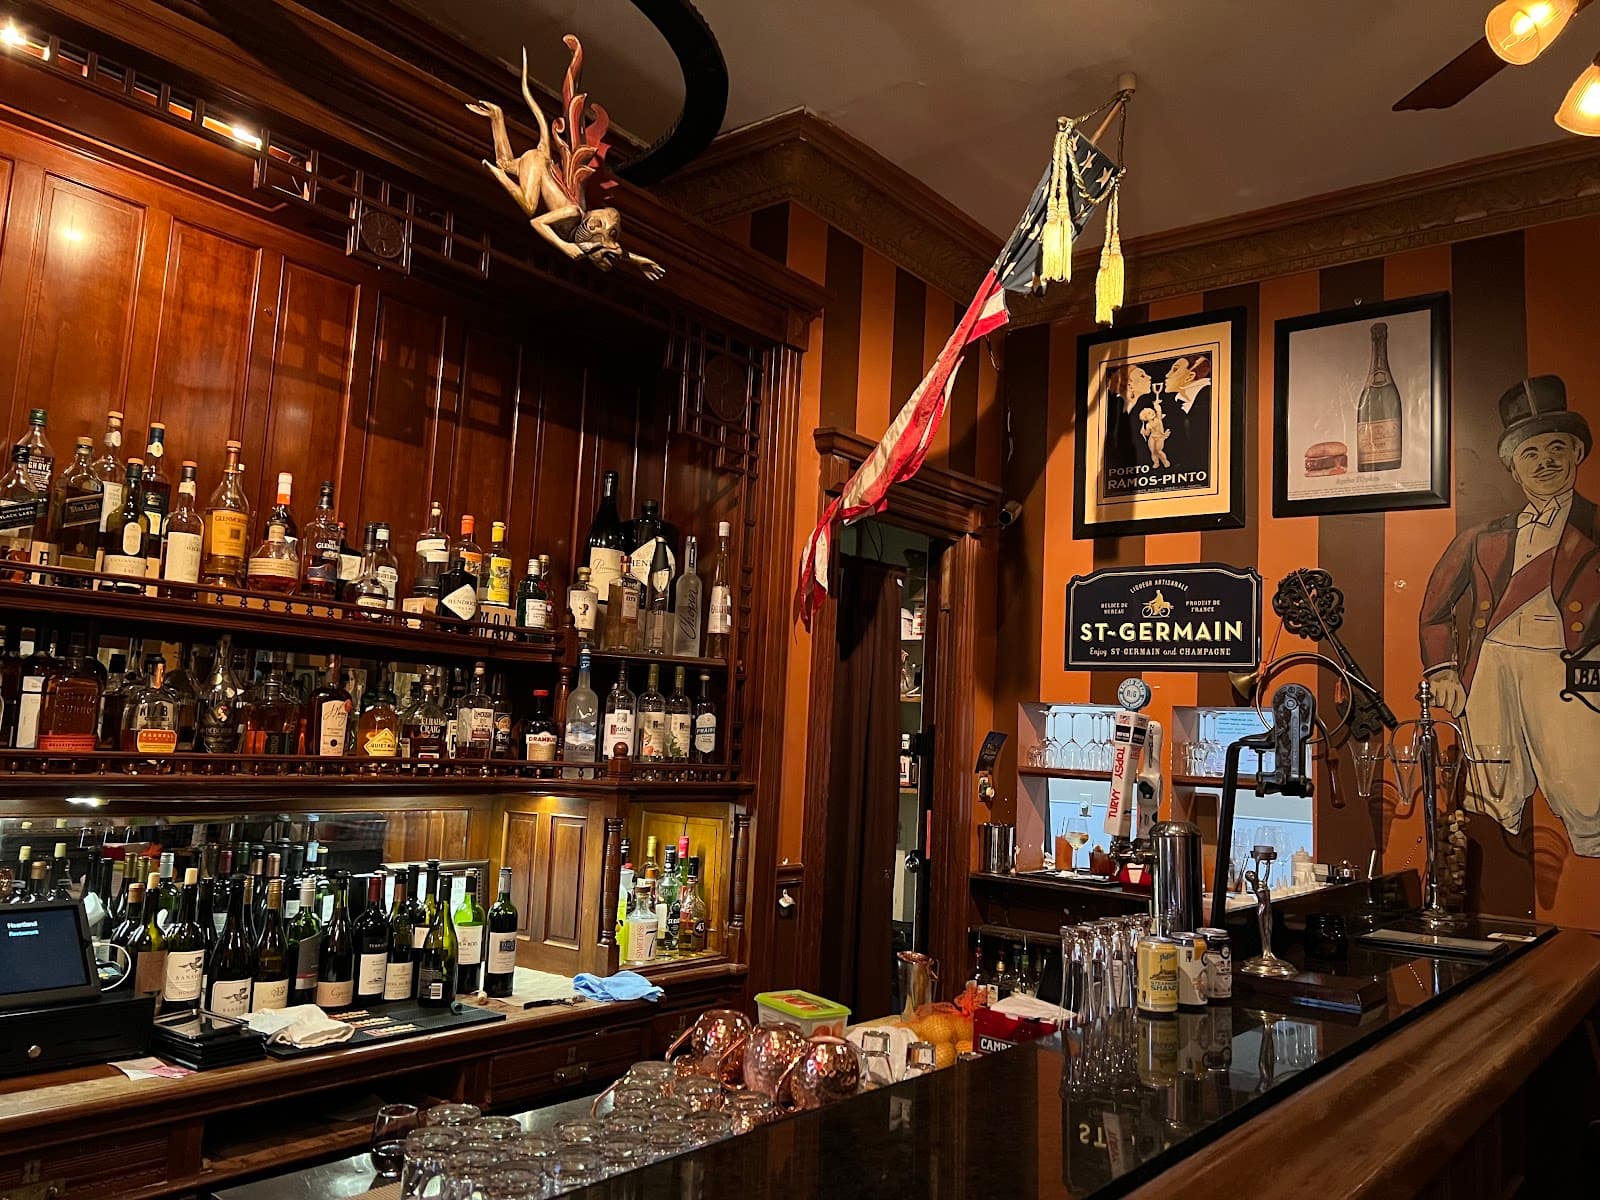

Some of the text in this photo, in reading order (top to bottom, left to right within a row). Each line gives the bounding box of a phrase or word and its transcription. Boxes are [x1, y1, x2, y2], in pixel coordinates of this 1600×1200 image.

[1108, 465, 1150, 477] PORTO
[1107, 471, 1207, 490] RAMOS-PINTO
[1129, 578, 1189, 594] LIQUEUR ARTISANALE
[1079, 620, 1244, 643] ST-GERMAIN
[1089, 647, 1231, 657] Enjoy ST-GERMAIN and CHAMPAGNE
[1108, 788, 1121, 818] TURVY
[1151, 984, 1177, 992] SHAND
